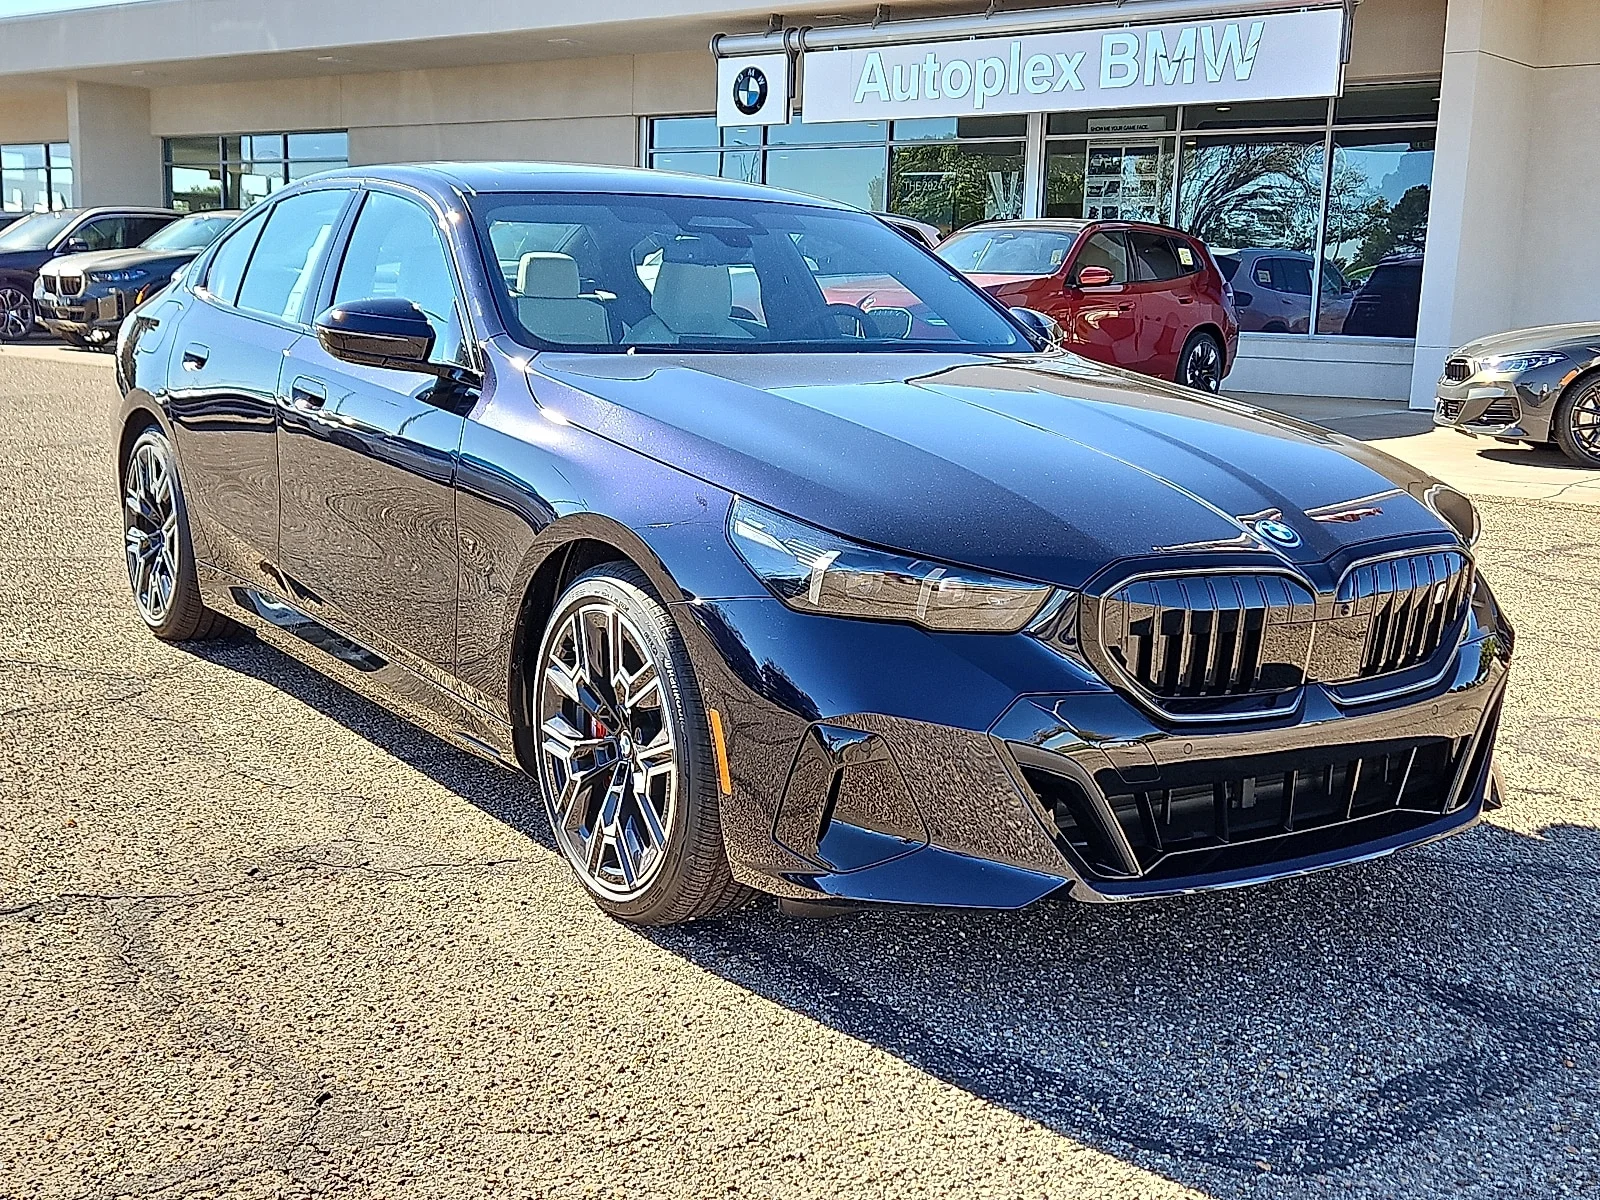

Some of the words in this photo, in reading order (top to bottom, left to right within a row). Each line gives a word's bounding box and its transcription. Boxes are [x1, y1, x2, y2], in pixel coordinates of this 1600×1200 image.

[853, 41, 1087, 109] Autoplex
[1099, 21, 1266, 89] BMW
[904, 181, 922, 191] THE
[923, 180, 943, 191] 2024
